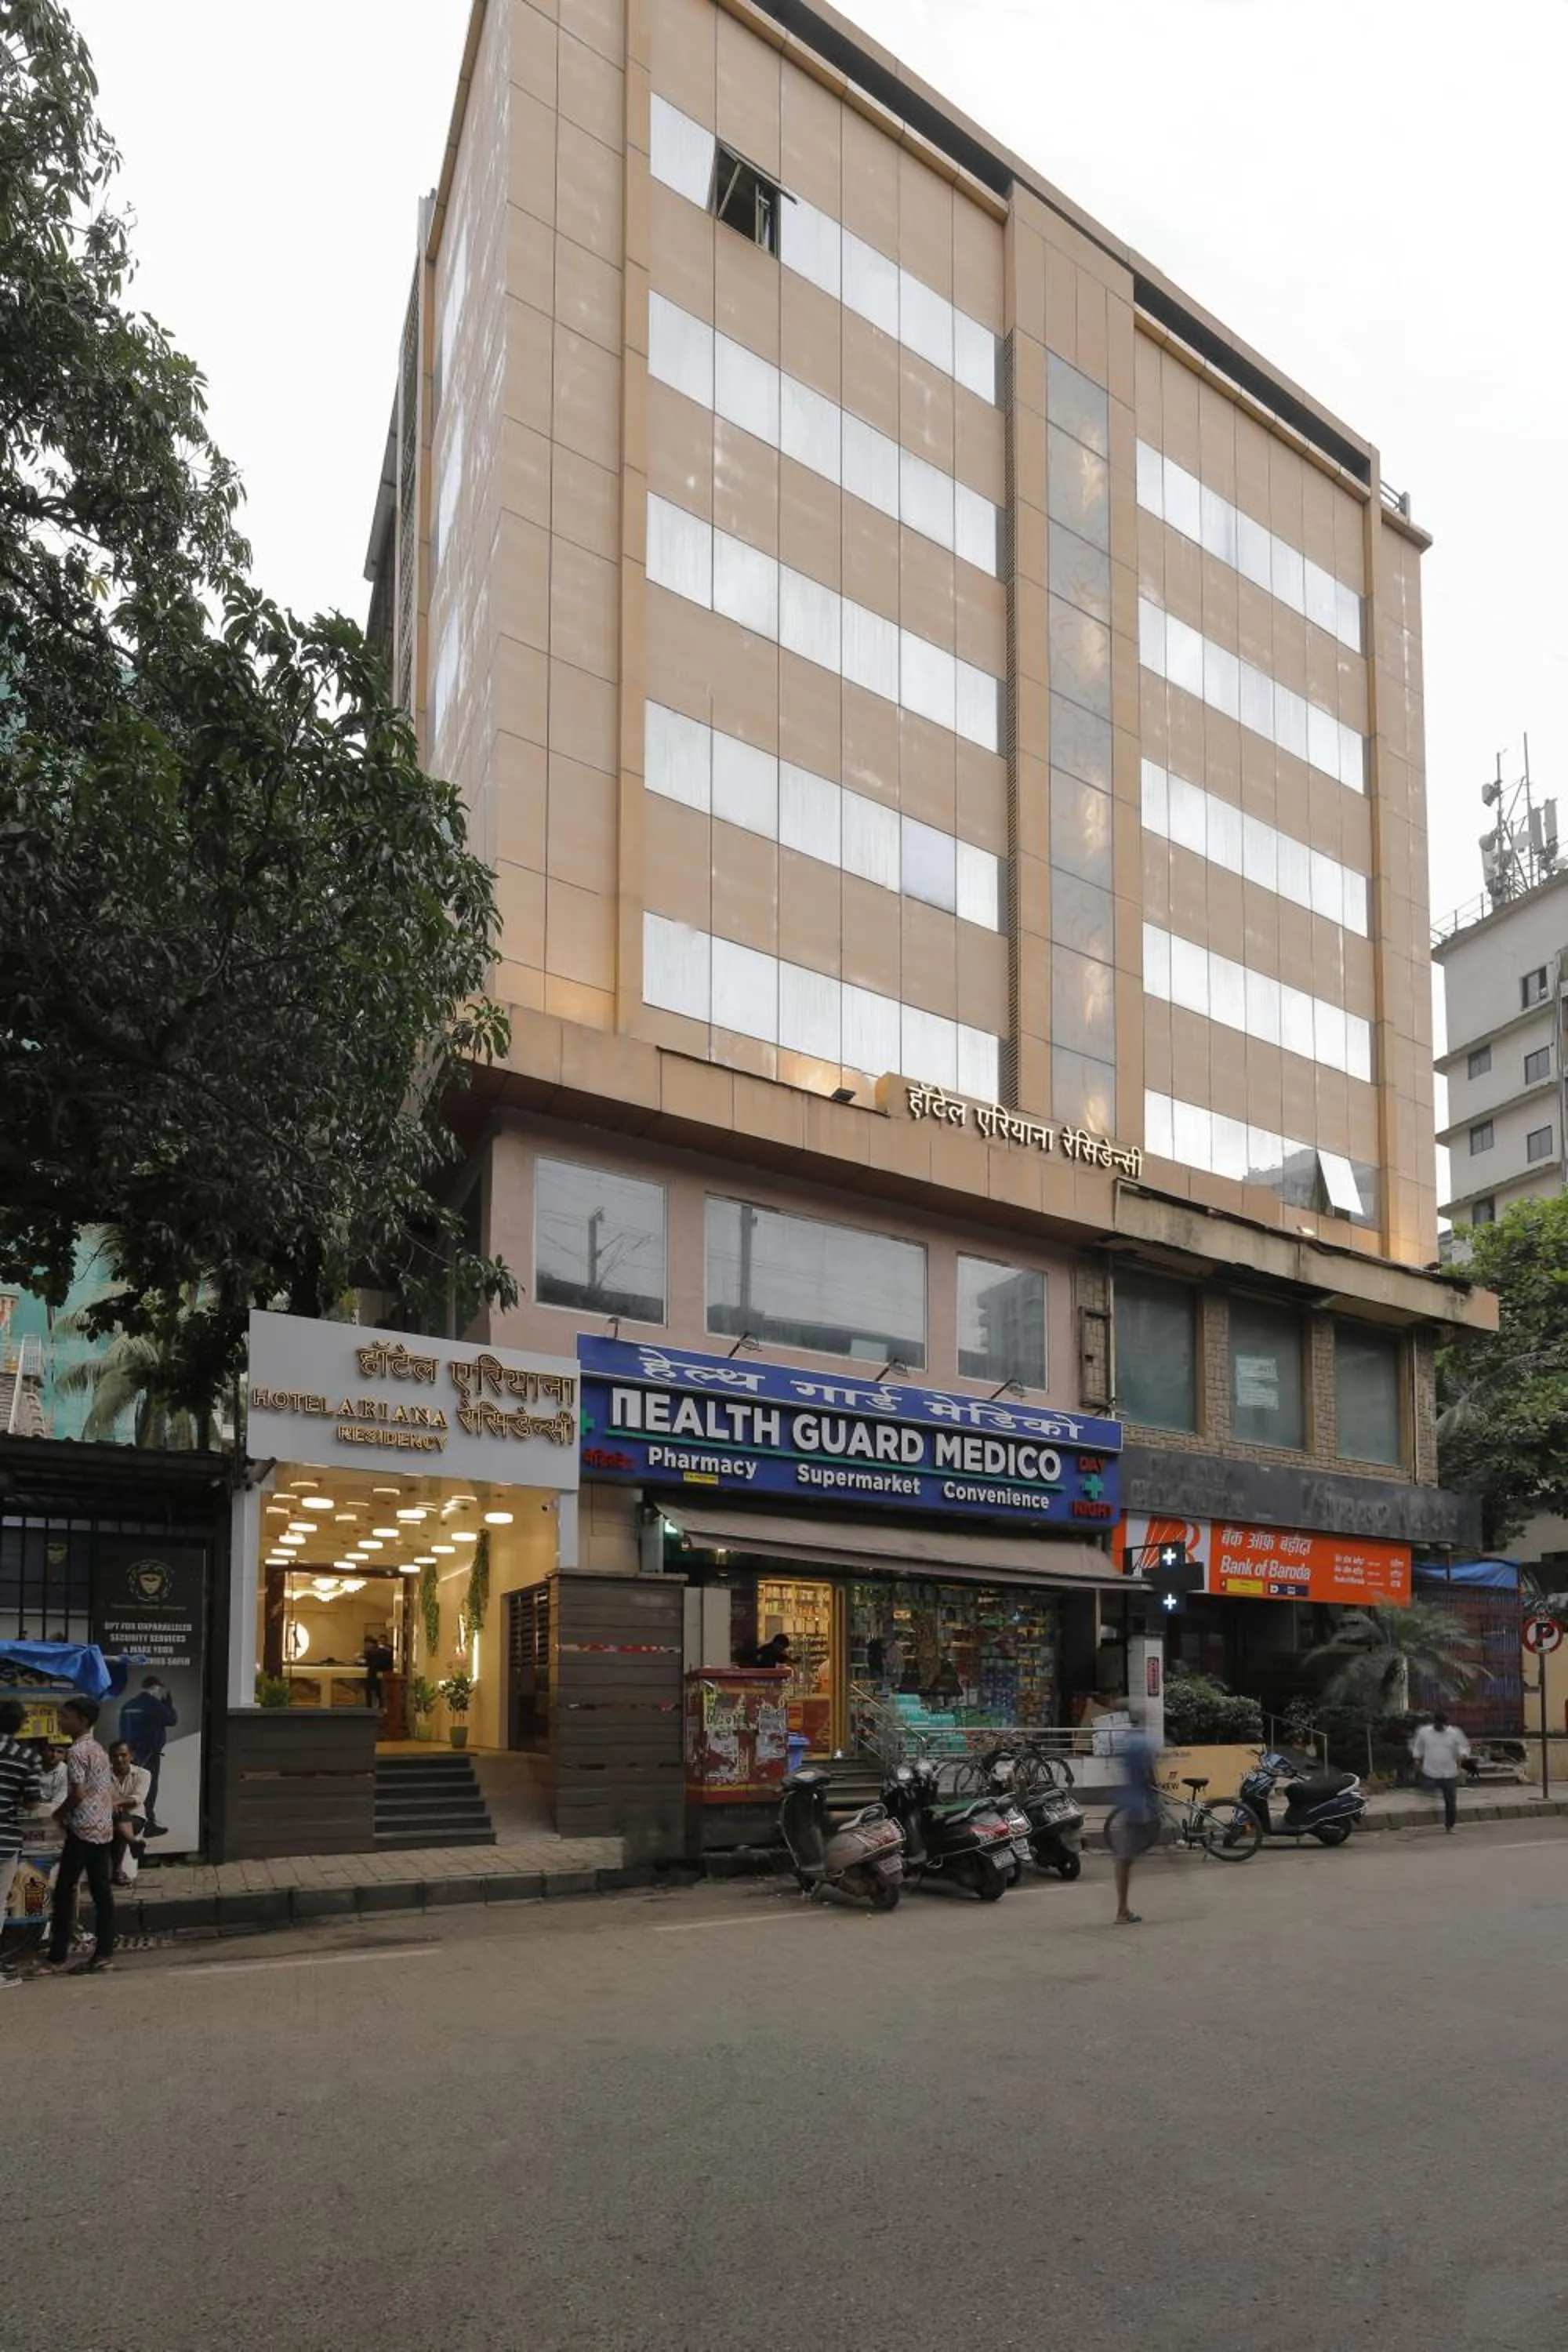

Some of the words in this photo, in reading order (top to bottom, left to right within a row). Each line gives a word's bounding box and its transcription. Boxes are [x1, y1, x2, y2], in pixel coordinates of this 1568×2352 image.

[907, 1082, 967, 1125] हॉटेल
[975, 1103, 1054, 1151] एरियाना
[356, 1340, 439, 1385] हॉटेल
[448, 1353, 577, 1407] एरियाना
[252, 1388, 332, 1416] HOTEL
[337, 1397, 449, 1428] ARIANA
[790, 1379, 902, 1410] गार्ड
[337, 1425, 449, 1452] RESIDENCY
[792, 1414, 924, 1465] GUARD
[935, 1432, 1062, 1483] MEDICO
[648, 1446, 757, 1480] Pharmacy
[797, 1463, 920, 1496] Supermarket
[943, 1480, 1049, 1510] Convenience
[1220, 1555, 1253, 1576] Bank
[1254, 1559, 1269, 1577] of
